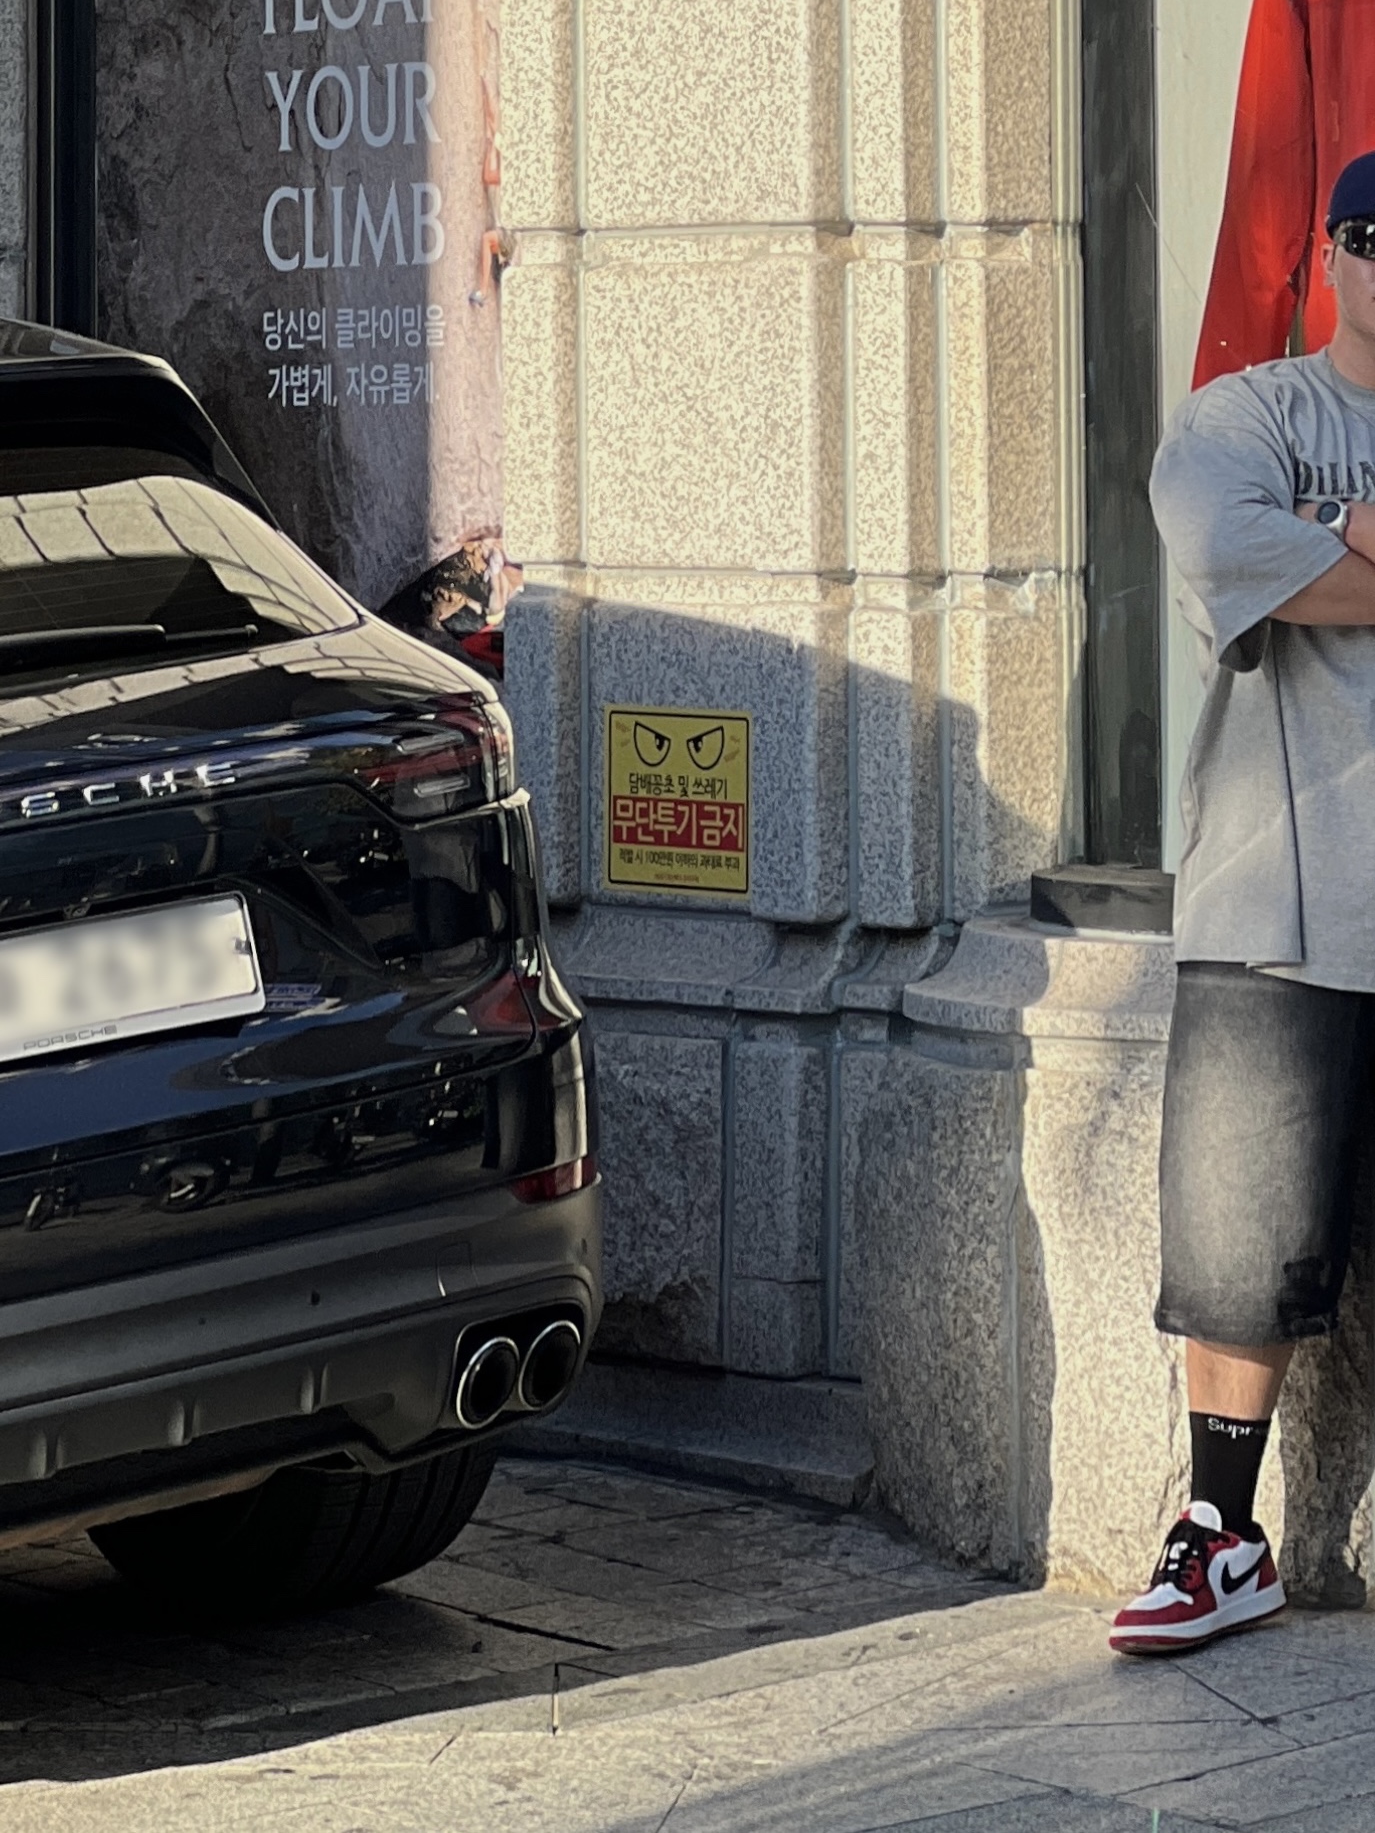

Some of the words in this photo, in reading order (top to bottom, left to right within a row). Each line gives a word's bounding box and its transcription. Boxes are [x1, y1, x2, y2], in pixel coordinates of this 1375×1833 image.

[265, 61, 442, 152] YOUR
[262, 180, 445, 272] CLIMB
[263, 306, 327, 350] 당신의
[335, 304, 446, 349] 클라이밍을
[268, 364, 338, 407] 가볍게,
[346, 361, 440, 406] 자유롭게.
[678, 774, 689, 798] 및
[692, 777, 728, 800] 쓰레기
[613, 798, 698, 846] 무단투기
[700, 805, 743, 849] 금지
[23, 1024, 118, 1051] PORSCHE
